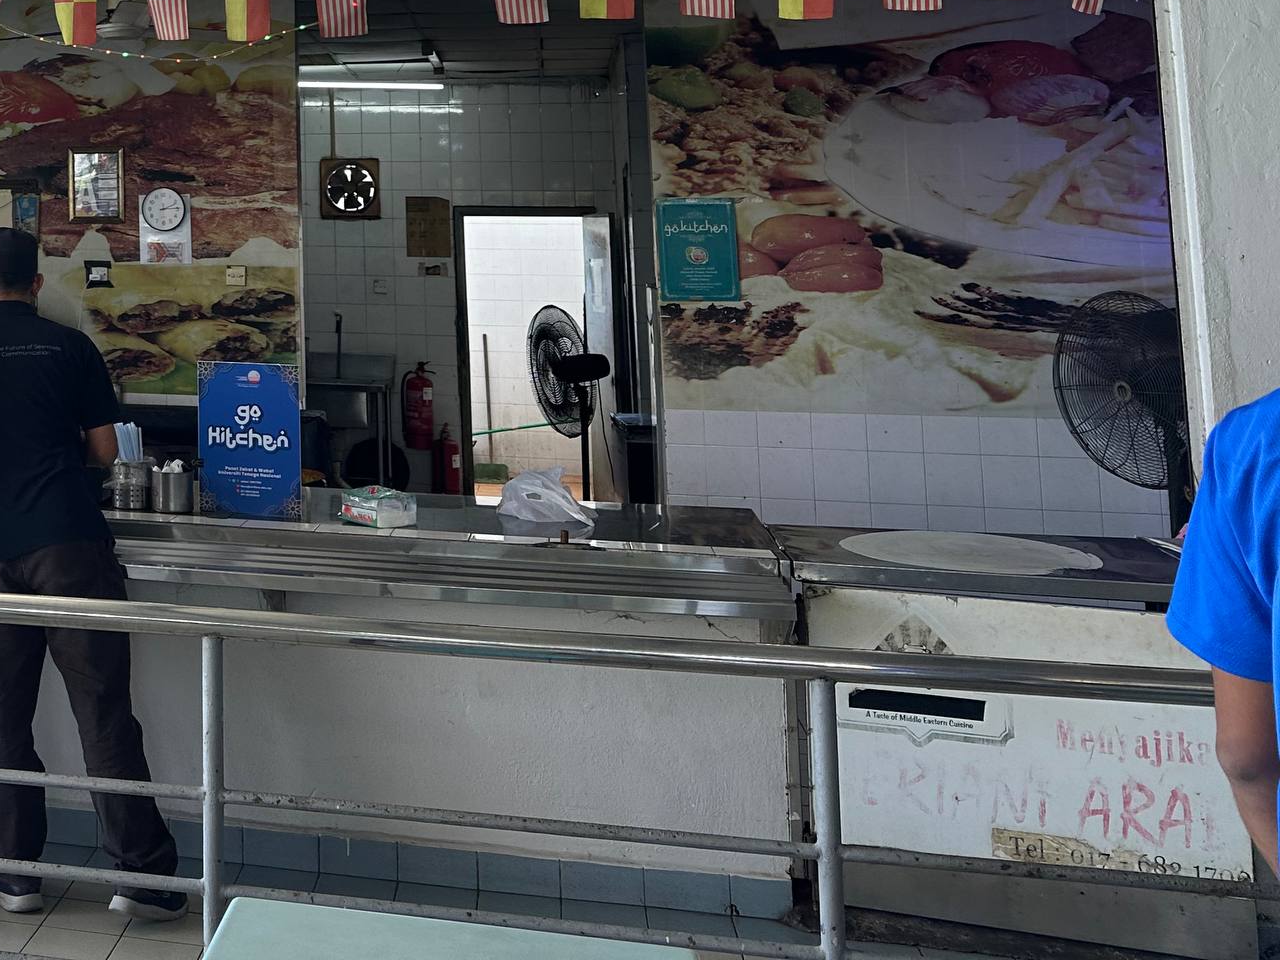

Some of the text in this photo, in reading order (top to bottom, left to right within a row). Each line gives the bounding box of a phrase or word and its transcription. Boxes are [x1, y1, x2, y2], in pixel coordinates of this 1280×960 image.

[234, 404, 261, 430] go
[1076, 774, 1220, 853] ARA
[1009, 836, 1046, 860] Tel
